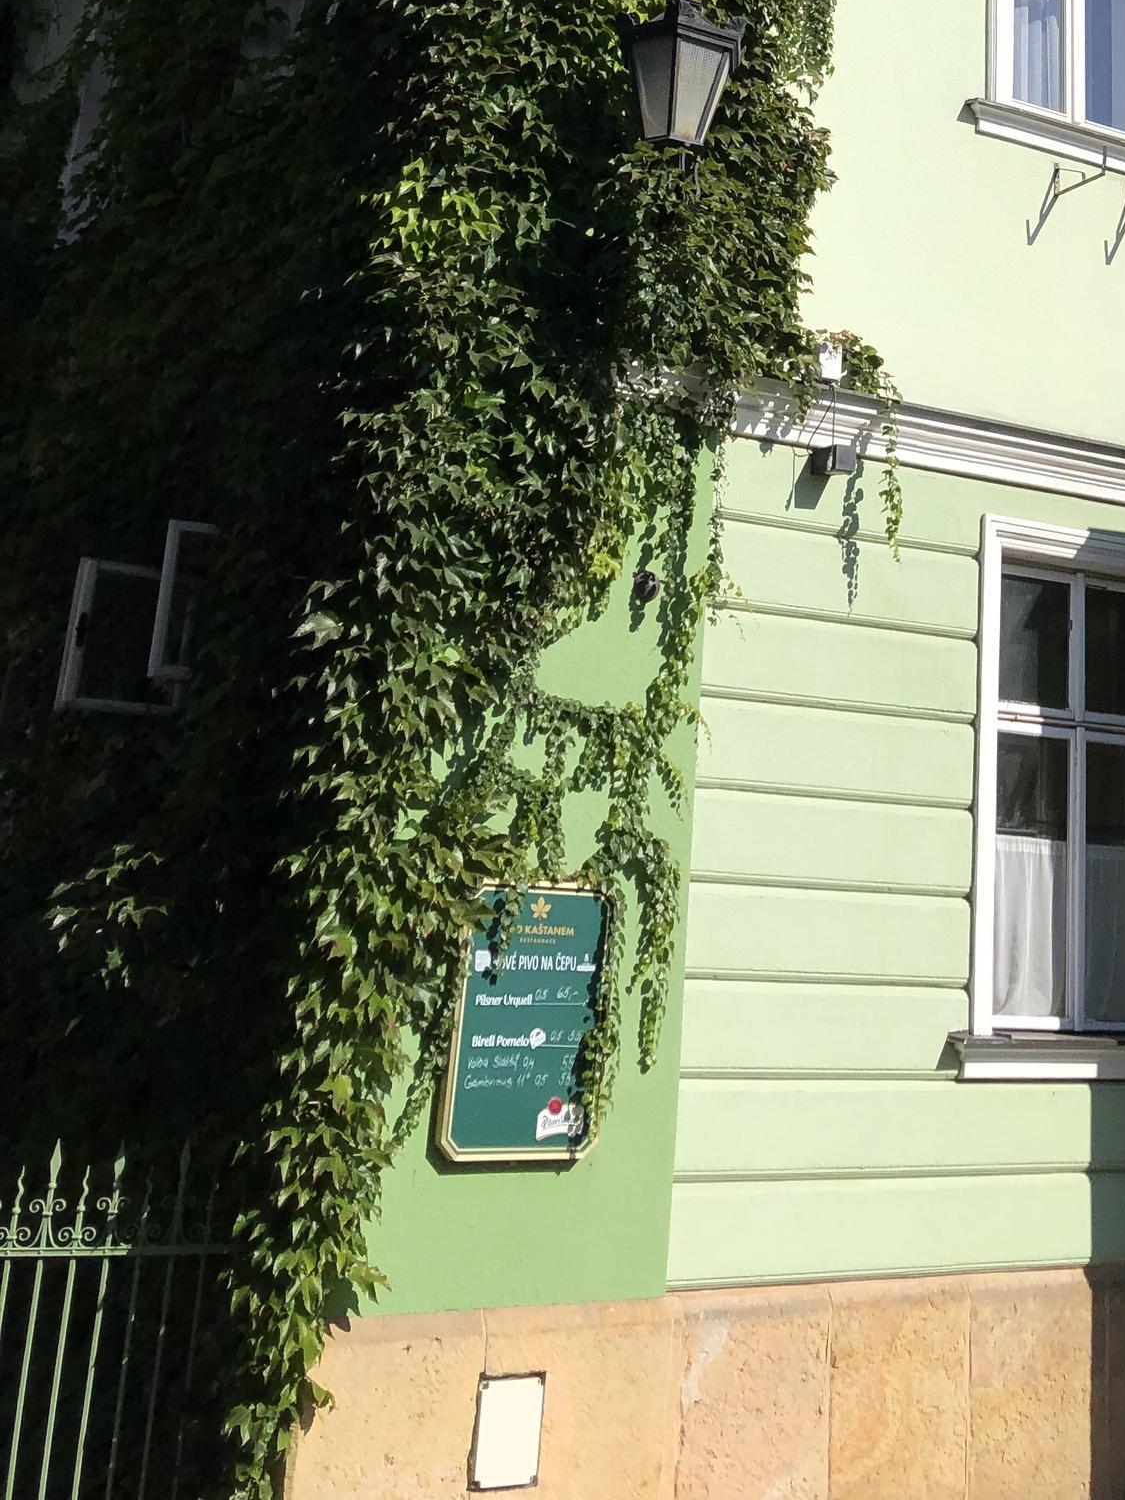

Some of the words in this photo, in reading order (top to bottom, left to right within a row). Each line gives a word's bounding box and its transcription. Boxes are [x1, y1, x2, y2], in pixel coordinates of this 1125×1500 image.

[525, 923, 575, 937] KAŠTANEM
[518, 954, 539, 971] PIVO
[540, 955, 554, 971] NA
[555, 951, 577, 971] ČEPU
[475, 994, 503, 1006] Pilsner
[503, 994, 533, 1008] Urquell
[471, 1034, 495, 1047] Birell
[496, 1034, 529, 1047] Pomelo
